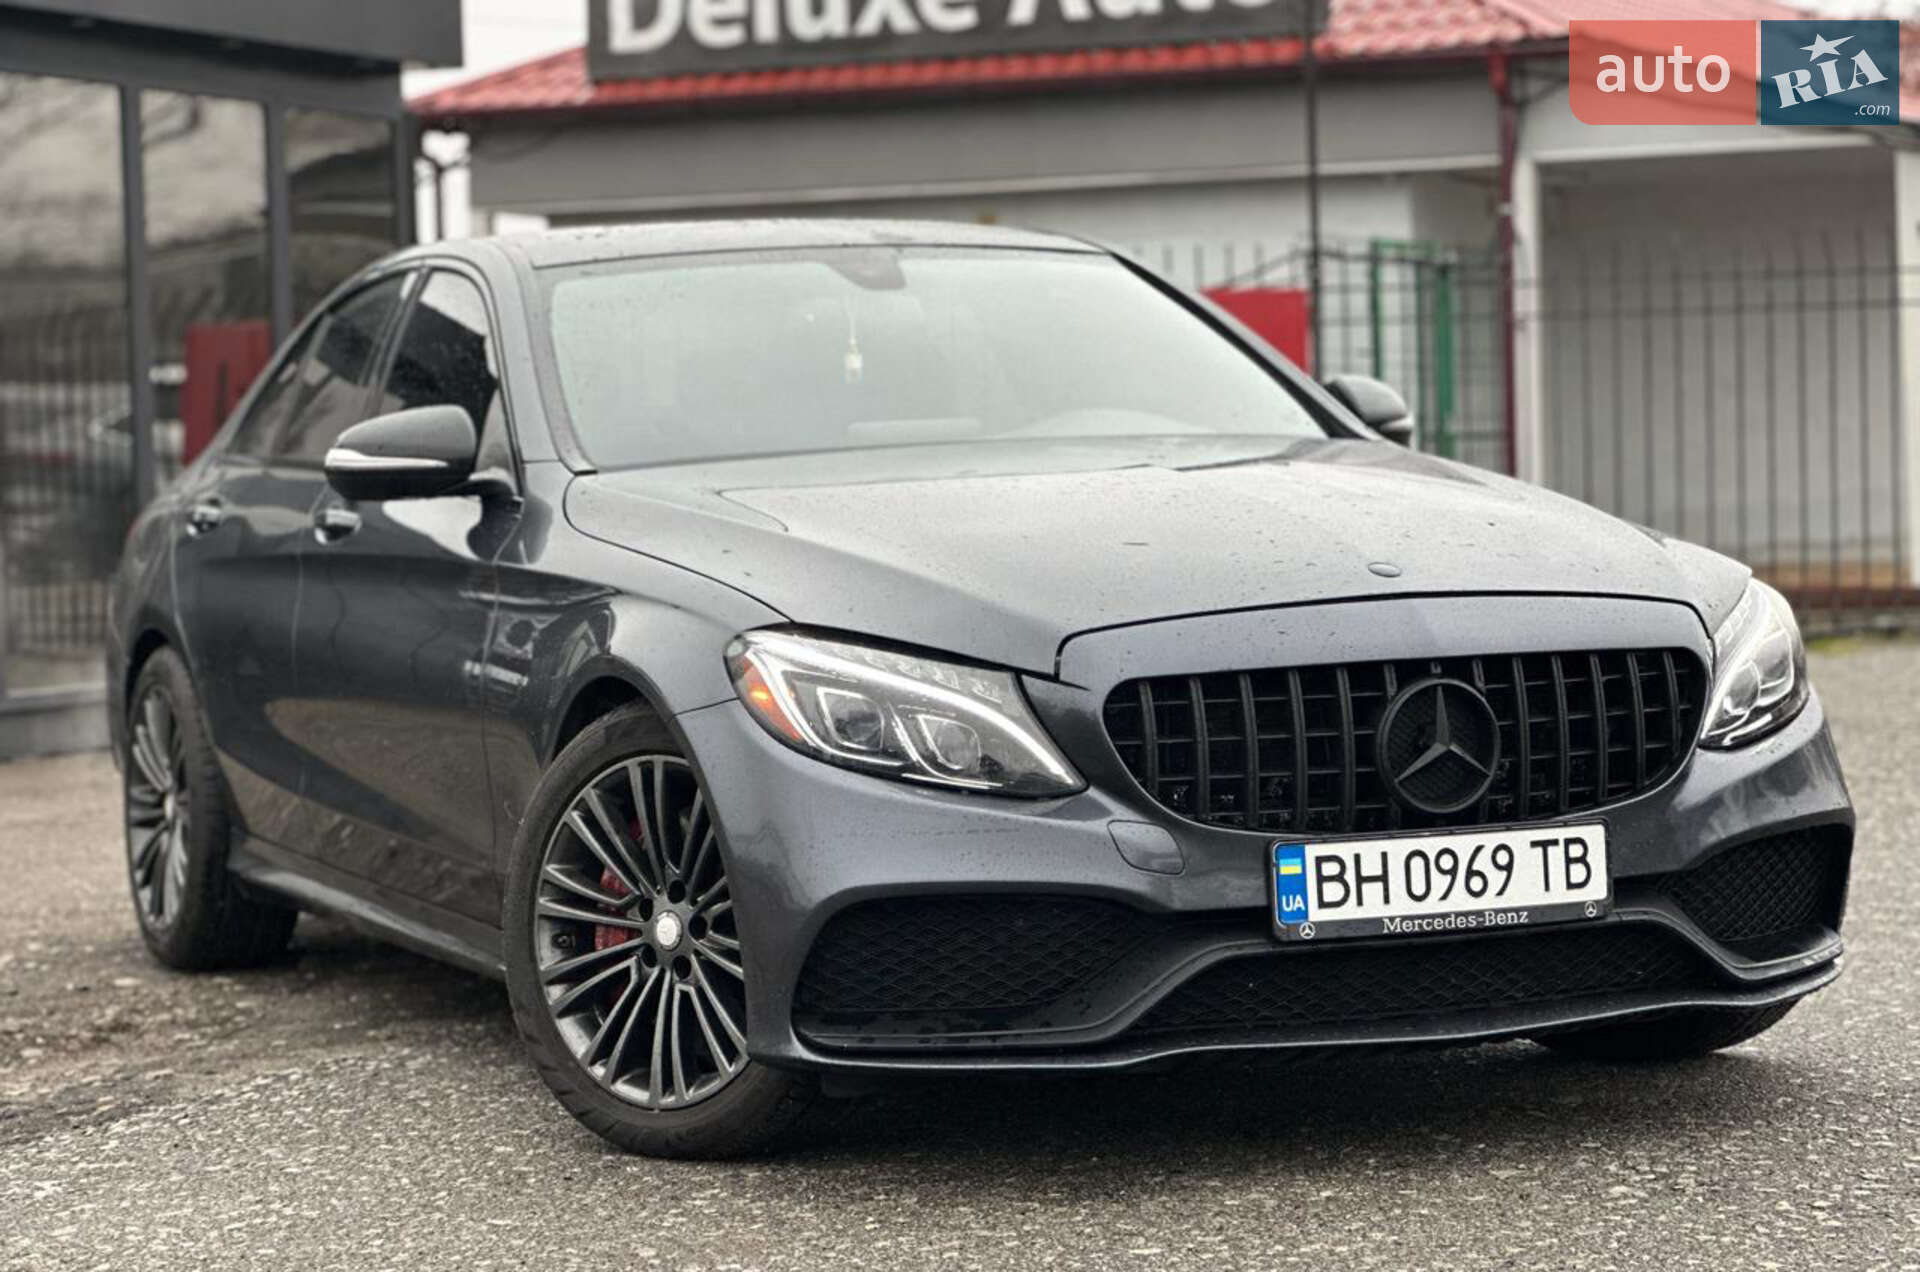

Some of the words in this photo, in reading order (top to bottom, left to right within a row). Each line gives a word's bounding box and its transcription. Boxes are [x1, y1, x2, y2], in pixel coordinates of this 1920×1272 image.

[1314, 851, 1390, 909] BH
[1403, 843, 1514, 902] 0969
[1529, 836, 1592, 892] TB
[1282, 893, 1305, 911] UA
[1382, 909, 1529, 934] Mercedes-Benz
